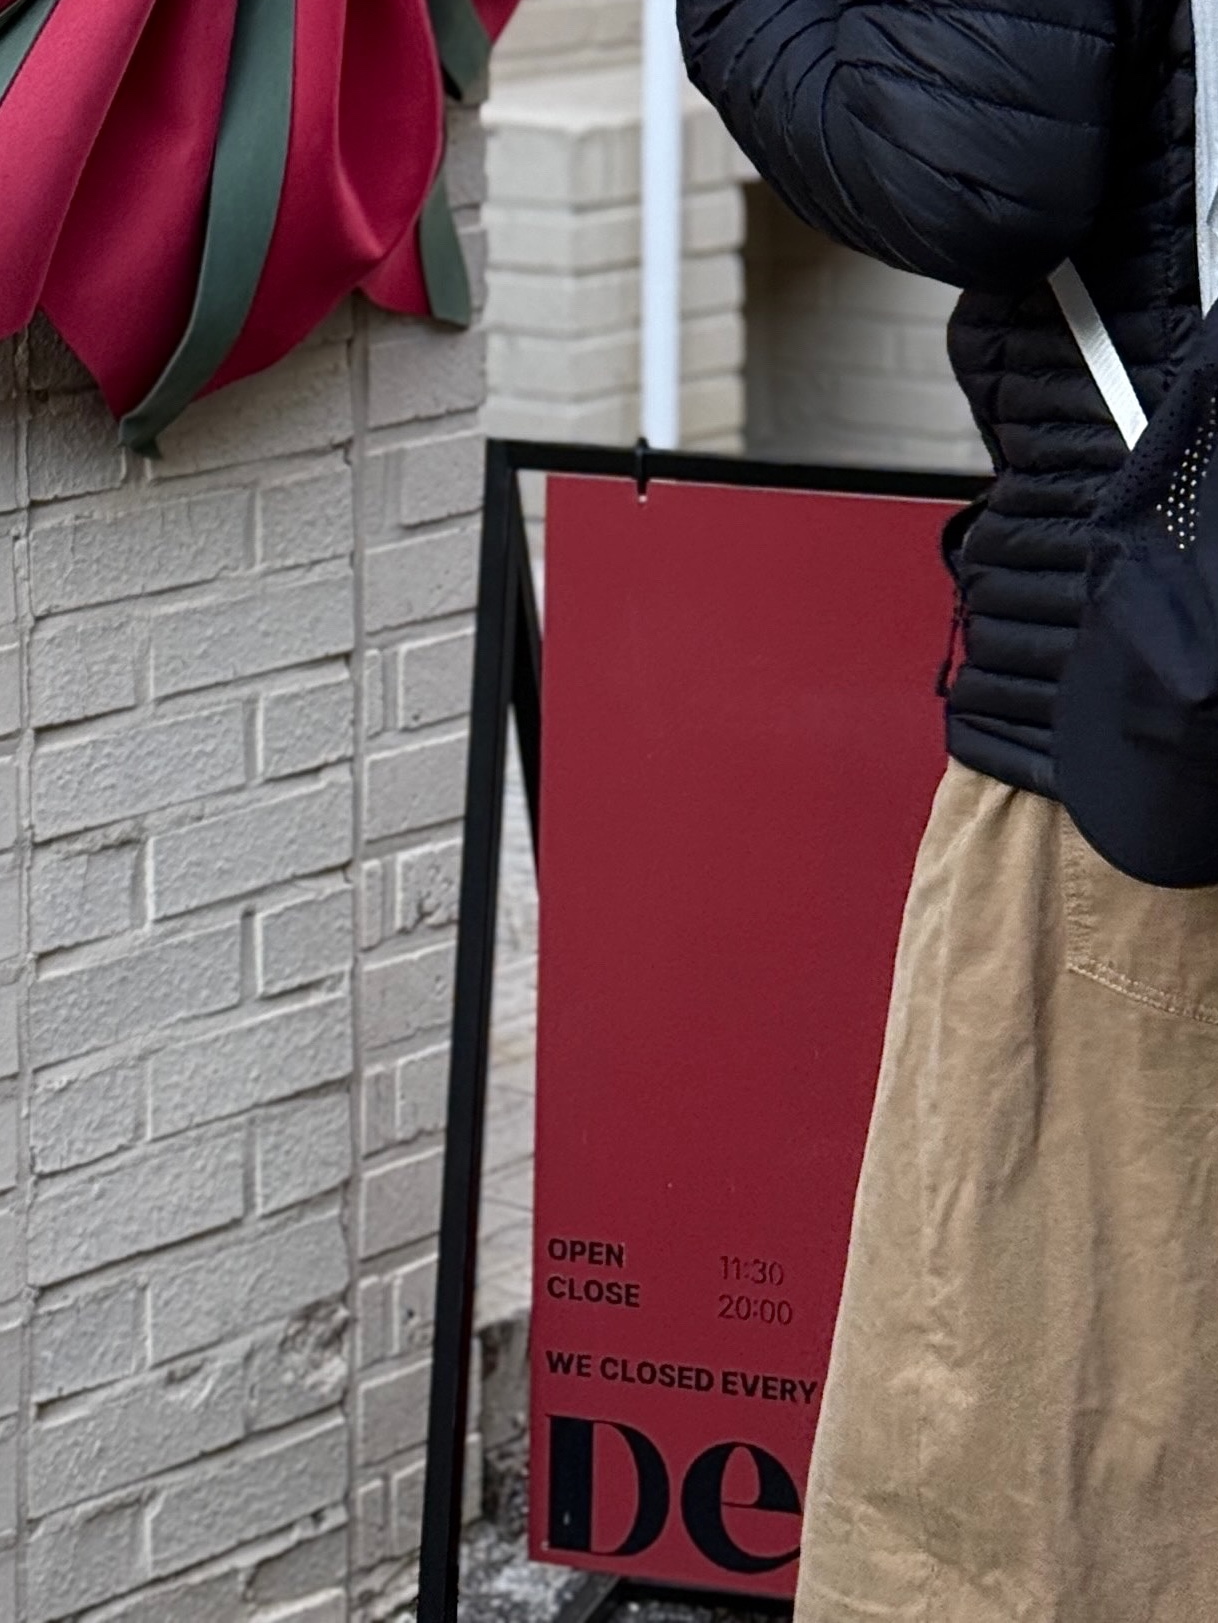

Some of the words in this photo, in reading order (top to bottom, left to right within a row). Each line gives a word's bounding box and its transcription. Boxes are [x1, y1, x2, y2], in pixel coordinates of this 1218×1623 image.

[547, 1237, 625, 1269] OPEN
[719, 1255, 785, 1287] 11:30
[546, 1276, 641, 1308] CLOSE
[717, 1293, 793, 1326] 20:00
[545, 1349, 592, 1378] WE
[599, 1356, 714, 1392] CLOSED
[720, 1370, 819, 1405] EVERY
